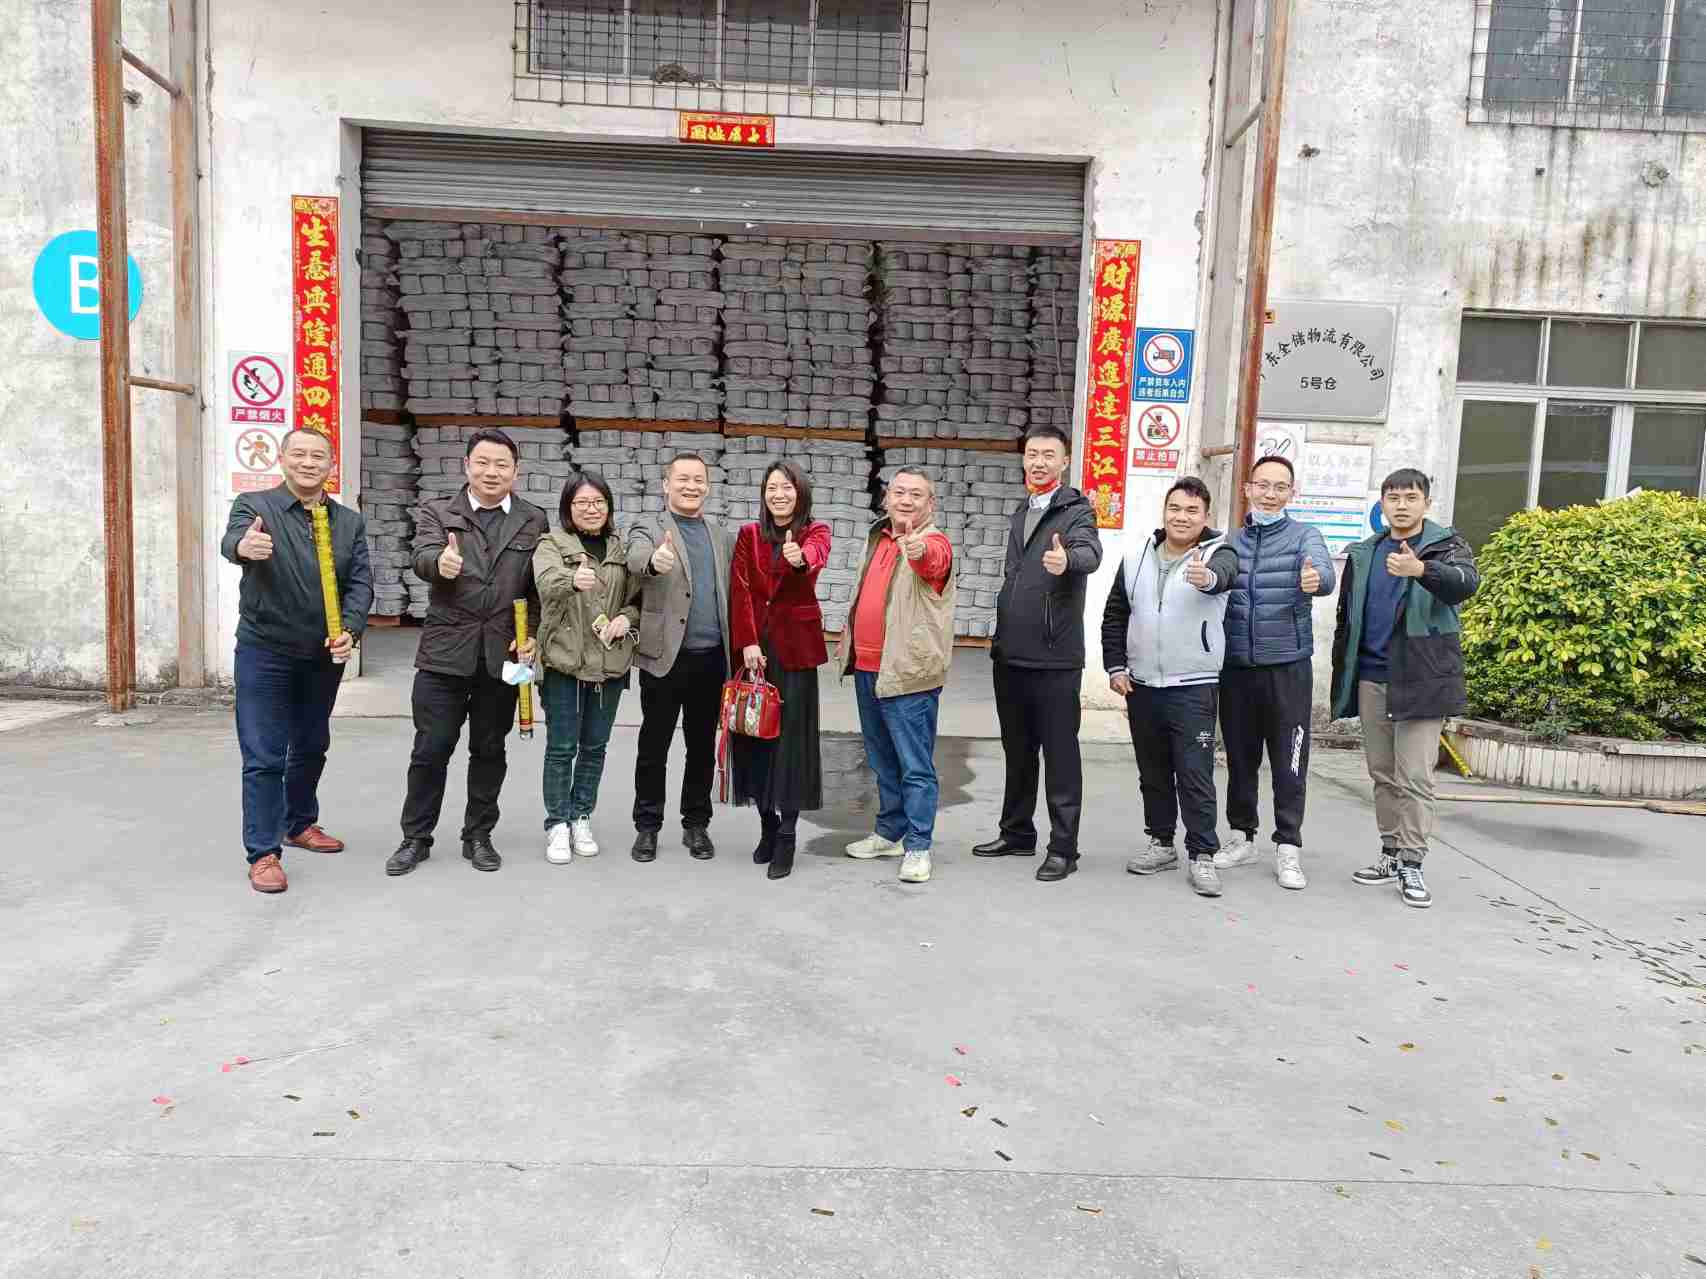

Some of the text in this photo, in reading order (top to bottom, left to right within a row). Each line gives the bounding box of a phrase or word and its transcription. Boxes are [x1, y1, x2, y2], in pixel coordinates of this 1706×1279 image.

[69, 254, 100, 314] B
[1260, 327, 1384, 381] 东全储物流有限公司
[1300, 376, 1336, 391] 5号仓
